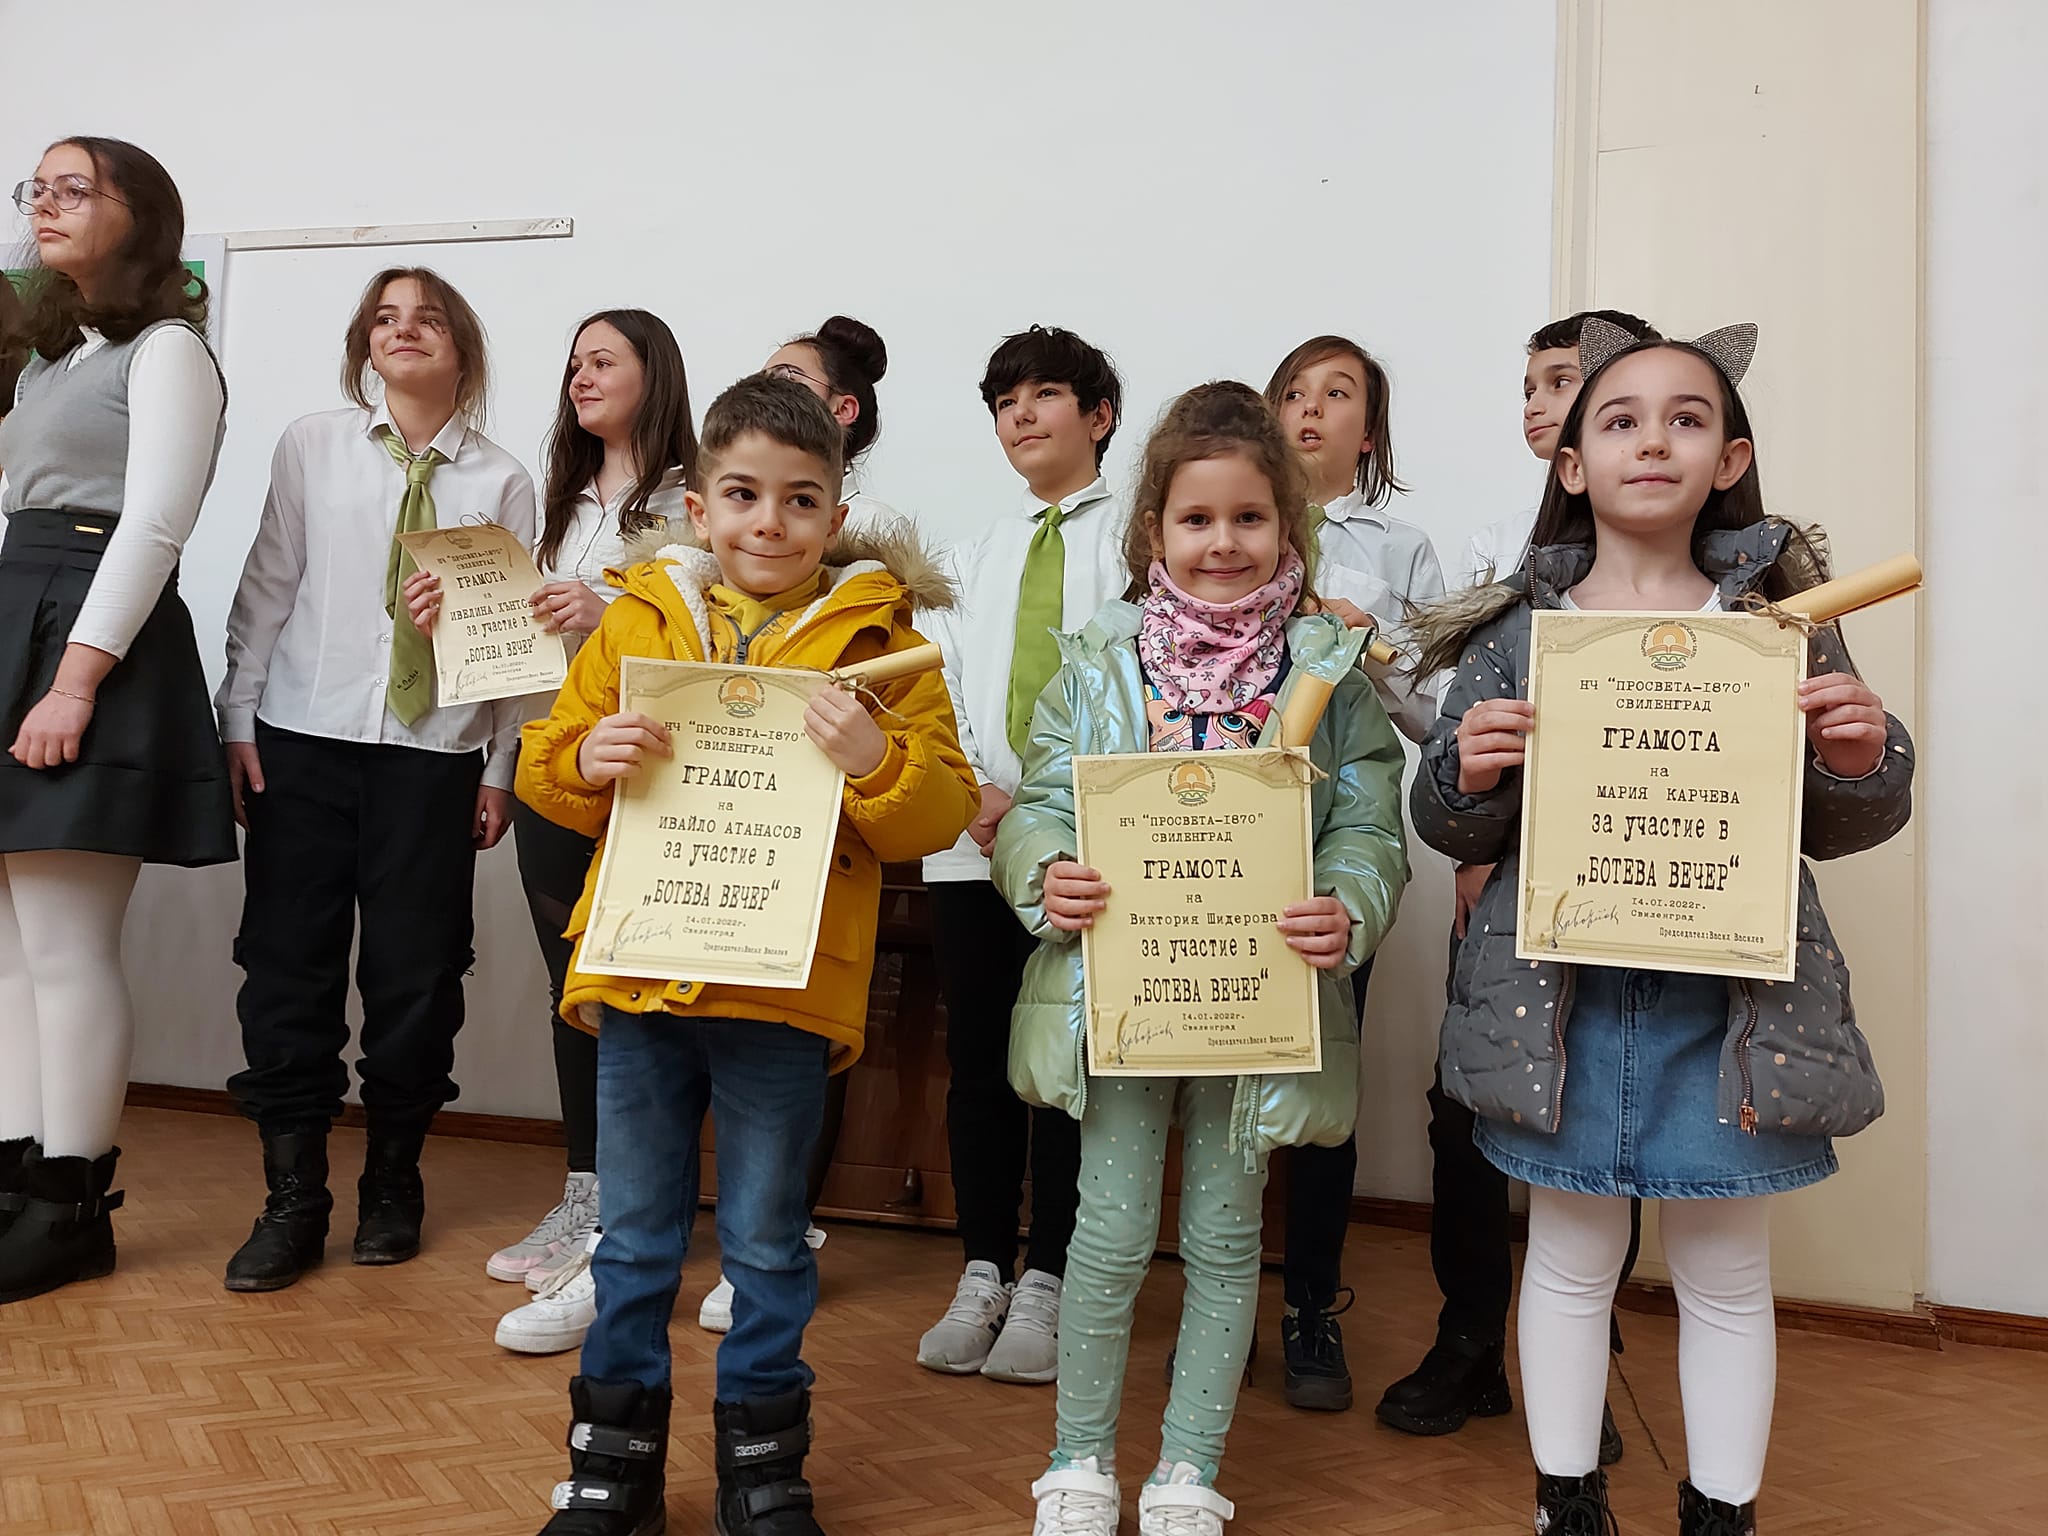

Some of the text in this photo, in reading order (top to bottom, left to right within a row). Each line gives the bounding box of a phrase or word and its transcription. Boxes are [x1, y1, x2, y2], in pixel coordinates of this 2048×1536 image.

[456, 570, 508, 589] ГРАМОТА
[450, 606, 494, 622] ИВЕЛИНА
[466, 616, 529, 638] за участие в
[464, 633, 537, 666] „БОТЕВА ВЕЧЕР“
[1579, 679, 1598, 690] НЧ
[1616, 698, 1712, 713] СВИЛЕНГРАД
[664, 720, 681, 732] НЧ
[695, 739, 775, 758] СВИЛЕНГРАД
[1602, 727, 1721, 753] ГРАМОТА
[681, 765, 778, 792] ГРАМОТА
[1650, 767, 1669, 777] на
[1596, 785, 1740, 804] МАРИЯ КАРЧЕВА
[717, 801, 734, 811] на
[657, 814, 802, 840] ИВАЙЛО АТАНАСОВ
[1119, 817, 1136, 827] НЧ
[1592, 813, 1729, 842] за участие в
[1151, 831, 1233, 843] СВИЛЕНГРАД
[663, 840, 776, 867] за участие в
[1143, 859, 1244, 880] ГРАМОТА
[1576, 855, 1740, 891] „БОТЕВА ВЕЧЕР“
[642, 879, 781, 911] „БОТЕВА ВЕЧЕР“
[1186, 893, 1202, 904] на
[1129, 912, 1278, 926] Виктория Шидерова
[1630, 909, 1695, 923] Свиленград
[1141, 937, 1258, 964] за участие в
[1134, 967, 1269, 1007] „БОТЕВА ВЕЧЕР“
[734, 1441, 779, 1457] Kappa
